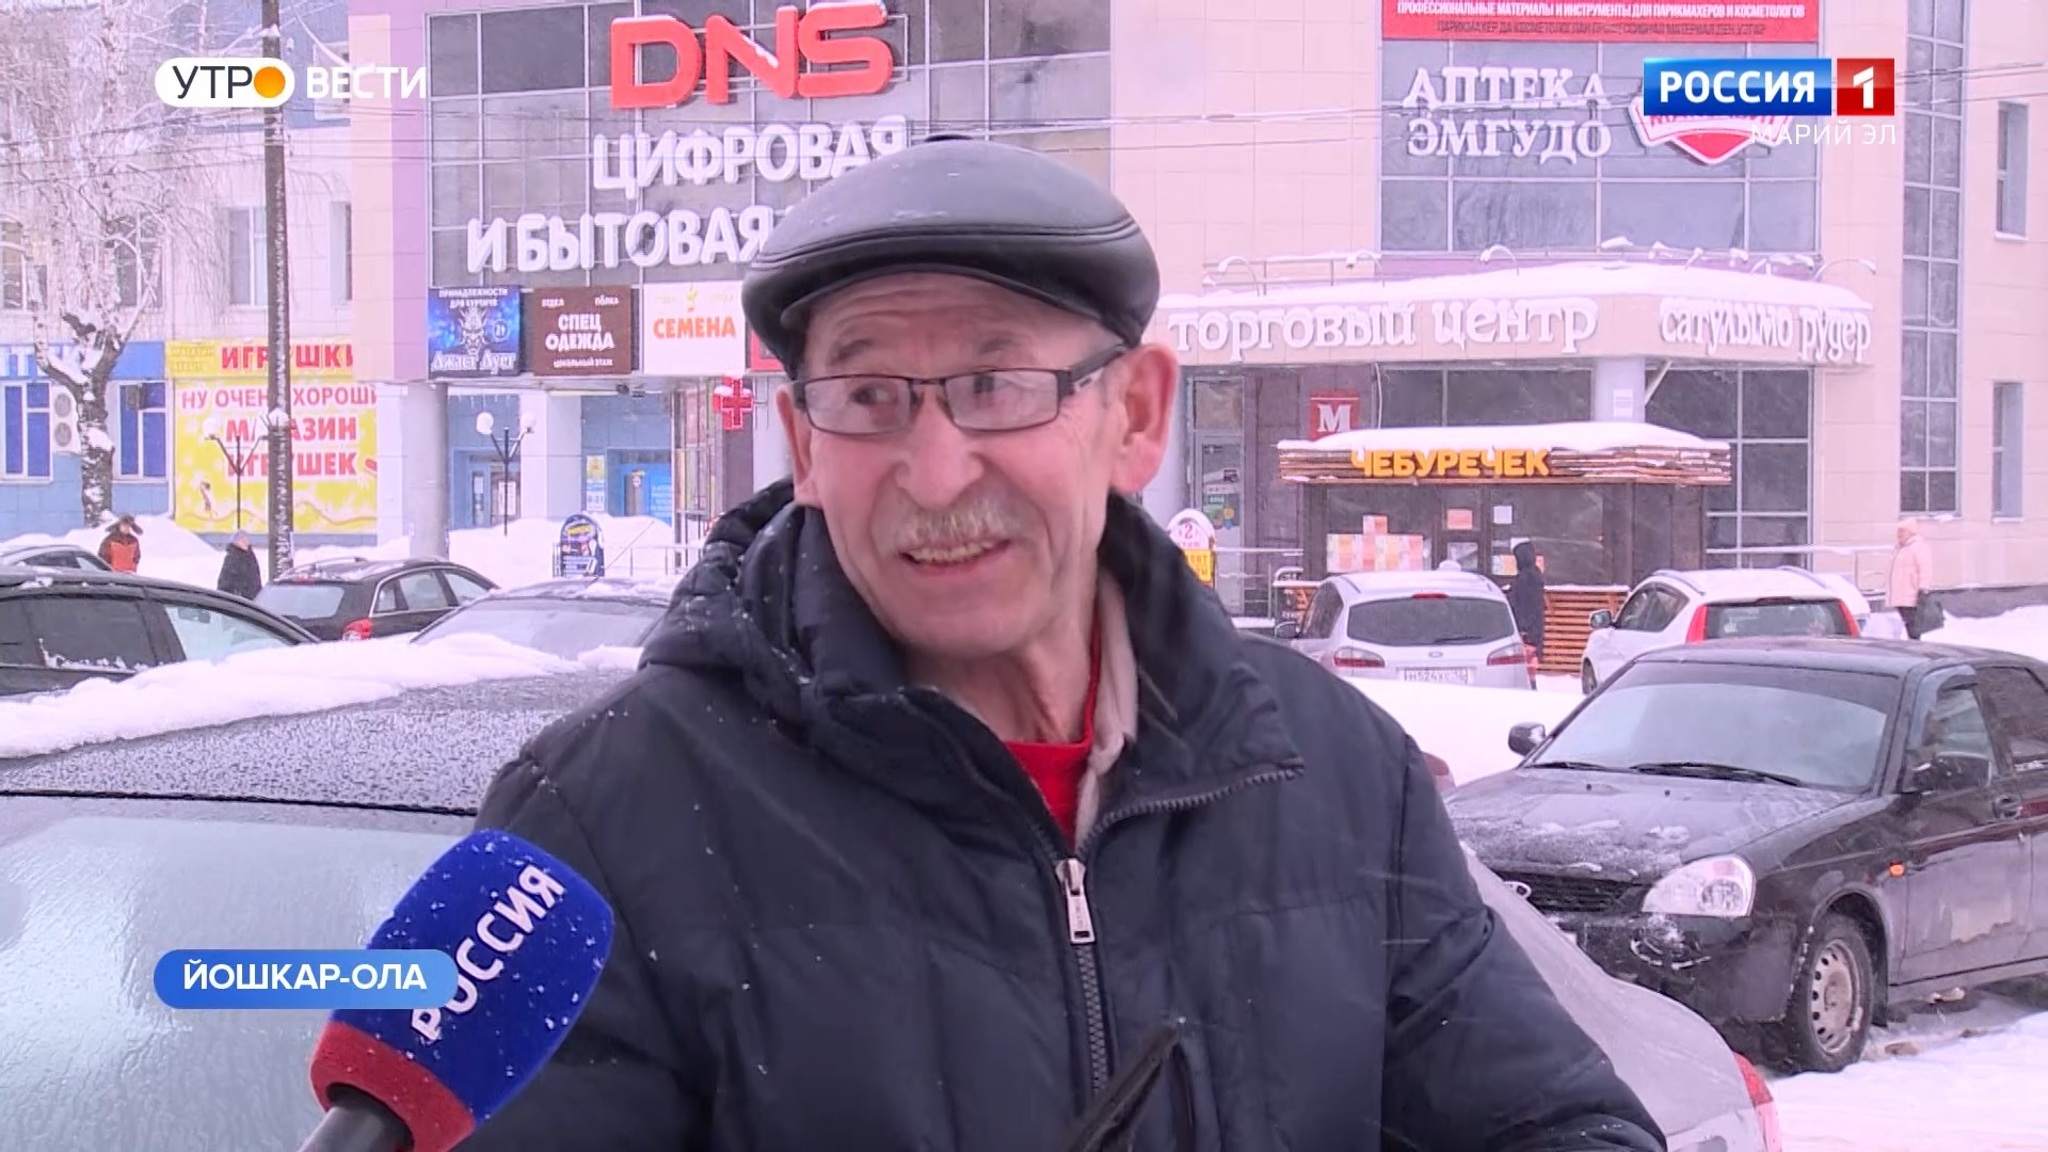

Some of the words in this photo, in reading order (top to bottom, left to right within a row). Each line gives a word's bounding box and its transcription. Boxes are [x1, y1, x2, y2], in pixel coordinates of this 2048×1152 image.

[1397, 2, 1497, 15] ПРОФЕССИОНАЛЬНЫЕ
[1498, 3, 1553, 16] МАТЕРИАЛЫ
[1563, 4, 1629, 17] ИНСТРУМЕНТЫ
[1631, 5, 1650, 17] ДЛЯ
[1652, 5, 1723, 17] ПАРИКМАХЕРОВ
[1734, 5, 1804, 17] КОСМЕТОЛОГОВ
[611, 1, 893, 109] DNS
[1402, 66, 1612, 111] АПТЕКА
[1407, 117, 1612, 164] ЭМГУДО
[592, 114, 907, 199] ЦИФРОВАЯ
[467, 217, 507, 273] И
[516, 204, 775, 272] БЫТОВАЯ
[558, 313, 602, 332] СПЕЦ
[653, 316, 737, 340] СЕМЕНА
[545, 332, 616, 353] ОДЕЖДА
[221, 344, 354, 370] ИГРШК
[182, 389, 208, 410] НУ
[215, 387, 269, 408] ОЧЕН
[225, 416, 357, 442] МАЗИН
[1316, 404, 1352, 432] М
[226, 452, 357, 477] ИГРШЕК
[1350, 448, 1550, 478] ЧЕБУРЕЧЕК
[411, 864, 566, 1042] РОССИЯ
